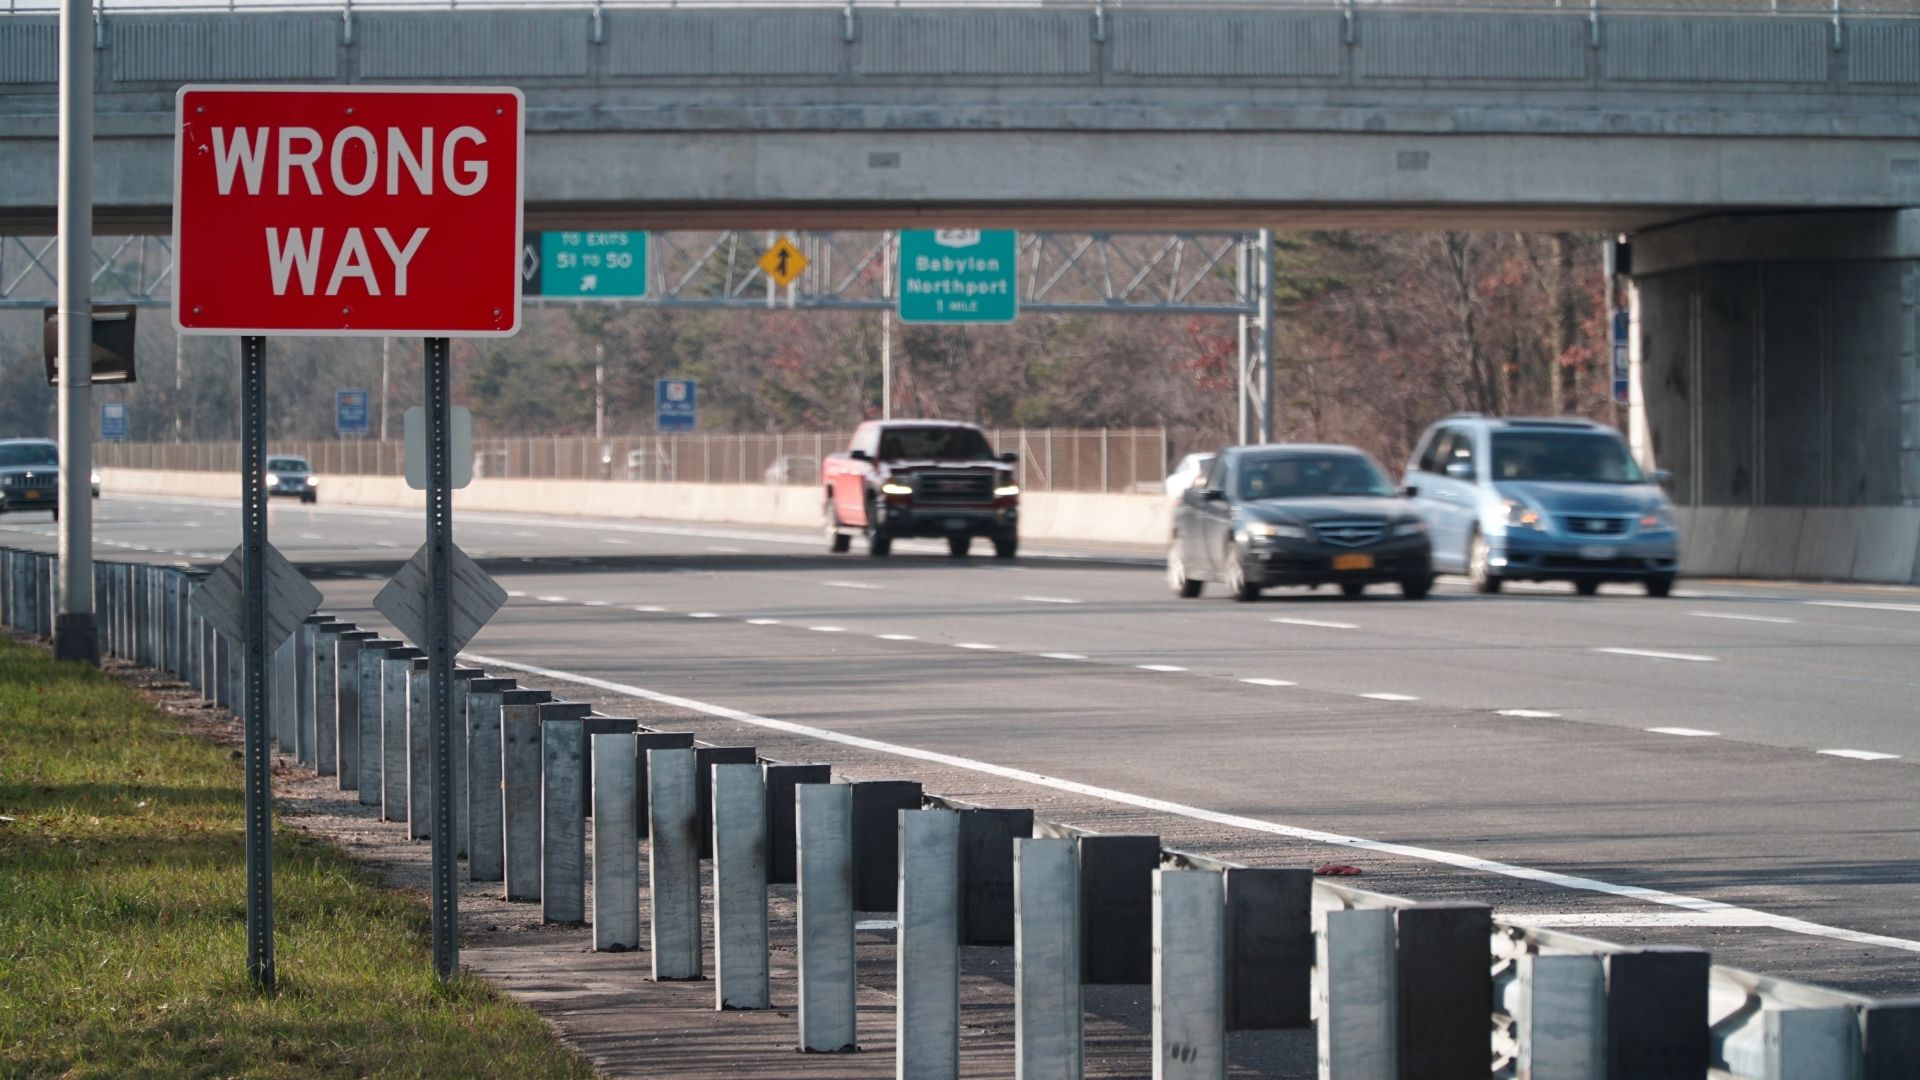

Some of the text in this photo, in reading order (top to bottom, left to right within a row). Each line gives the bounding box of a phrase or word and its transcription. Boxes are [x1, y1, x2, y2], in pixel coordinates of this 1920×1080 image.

[211, 126, 489, 196] WRONG
[562, 231, 629, 246] TO EXITS
[265, 227, 431, 296] WAY
[556, 252, 633, 268] 51 TO 50
[916, 255, 1000, 274] Babylon
[907, 278, 1007, 297] Northport
[936, 299, 978, 313] 1 MILE
